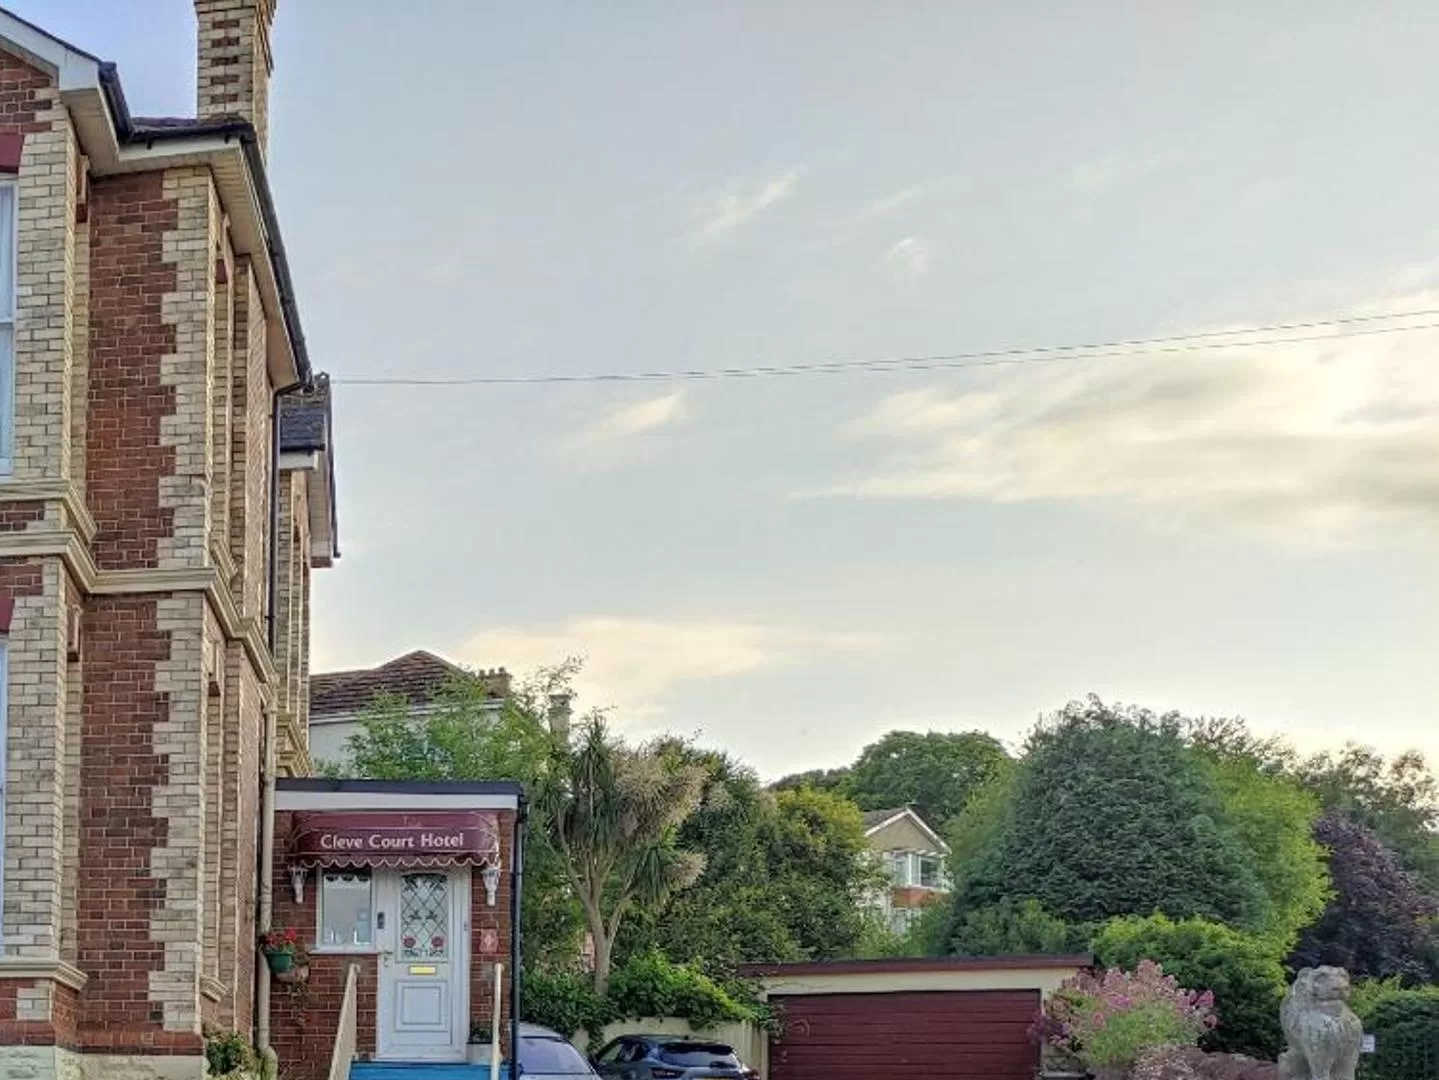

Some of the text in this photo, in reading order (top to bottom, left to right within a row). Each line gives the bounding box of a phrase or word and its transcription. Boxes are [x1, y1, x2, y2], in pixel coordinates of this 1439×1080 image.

[320, 832, 464, 849] Cleve Court Hotel
